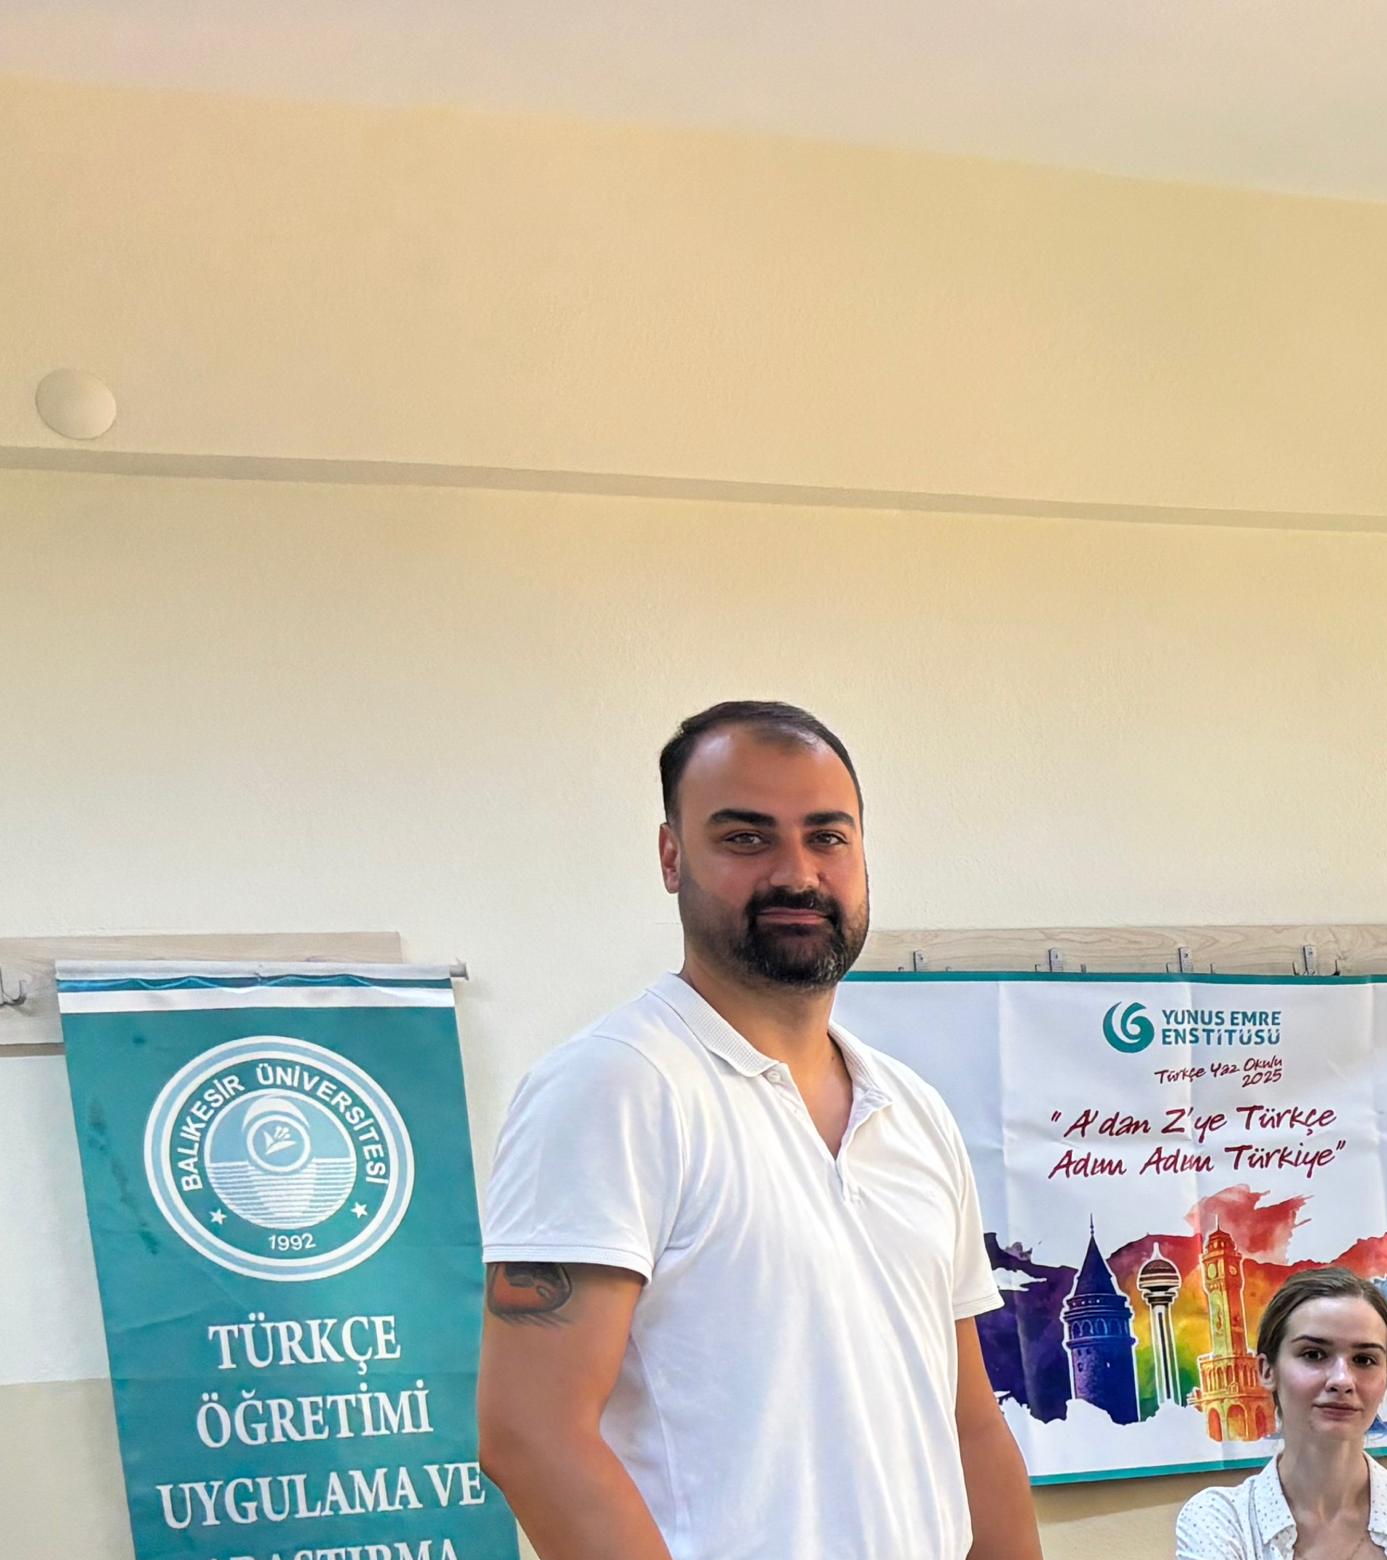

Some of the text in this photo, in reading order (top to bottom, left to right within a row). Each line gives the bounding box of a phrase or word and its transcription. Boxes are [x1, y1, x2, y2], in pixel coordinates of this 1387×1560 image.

[1162, 1010, 1281, 1026] YUNUS EMRE
[1162, 1028, 1281, 1045] ENSTİTÜSÜ
[1154, 1055, 1283, 1085] Türkçe Yaz Okulu
[1242, 1068, 1282, 1088] 2025
[180, 1062, 389, 1193] BALIKESİR ÜNİVERSİTESİ
[1161, 1107, 1227, 1142] Z'ye
[1237, 1105, 1337, 1135] Türkçe
[1048, 1146, 1127, 1179] Adım
[1139, 1146, 1214, 1176] Adım
[268, 1233, 316, 1252] 1992
[208, 1313, 401, 1377] TÜRKÇE
[196, 1379, 433, 1449] ÖĞRETİMİ
[156, 1461, 486, 1531] UYGULAMA VE
